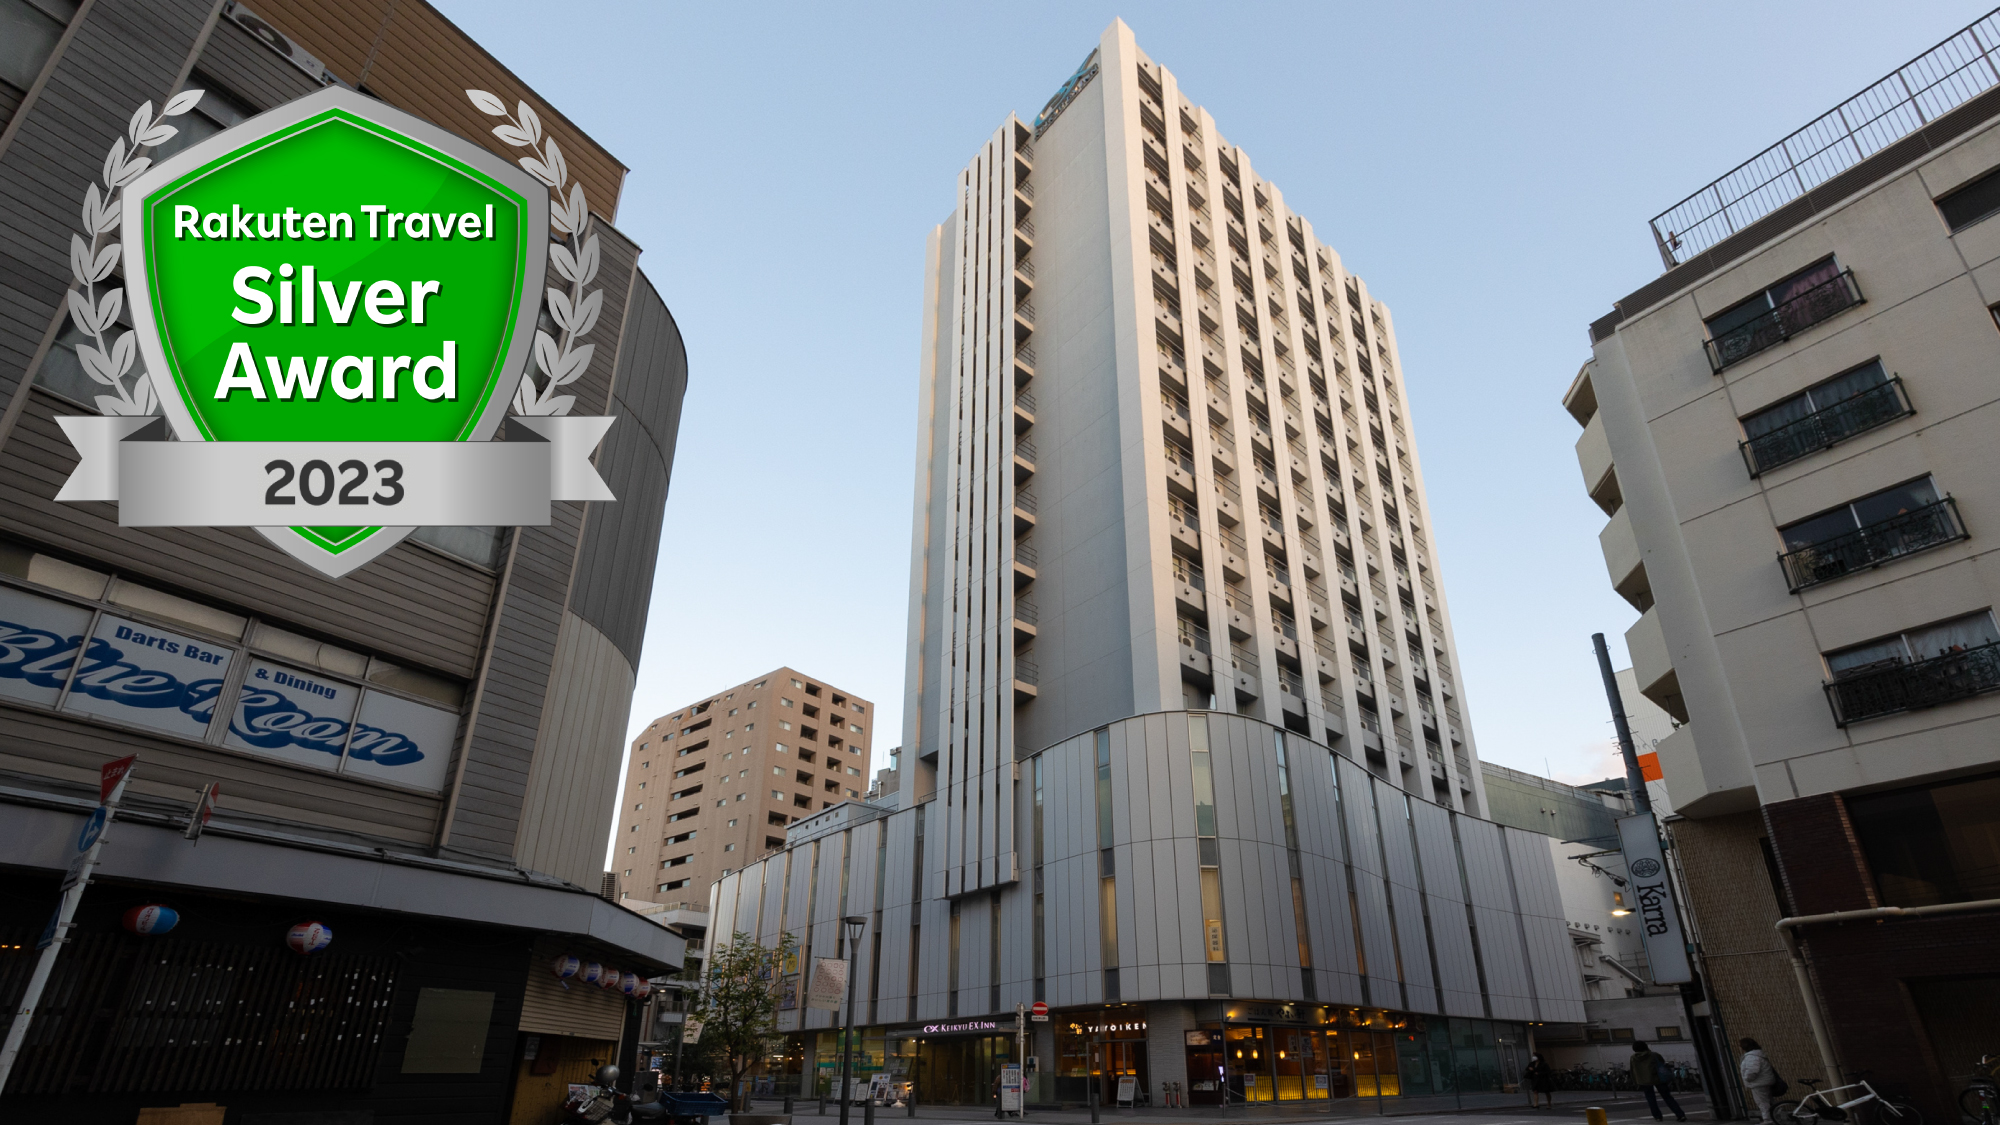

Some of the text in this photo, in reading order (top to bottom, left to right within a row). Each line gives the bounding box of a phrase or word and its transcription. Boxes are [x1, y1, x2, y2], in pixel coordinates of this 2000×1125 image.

[114, 625, 224, 666] Darts Bar
[0, 622, 421, 764] Blue Room
[255, 668, 337, 700] & Dining
[103, 764, 124, 780] 止まれ
[1636, 881, 1668, 937] Karra
[941, 1023, 968, 1032] KEIKYU
[968, 1021, 979, 1031] EX
[980, 1021, 996, 1030] INN
